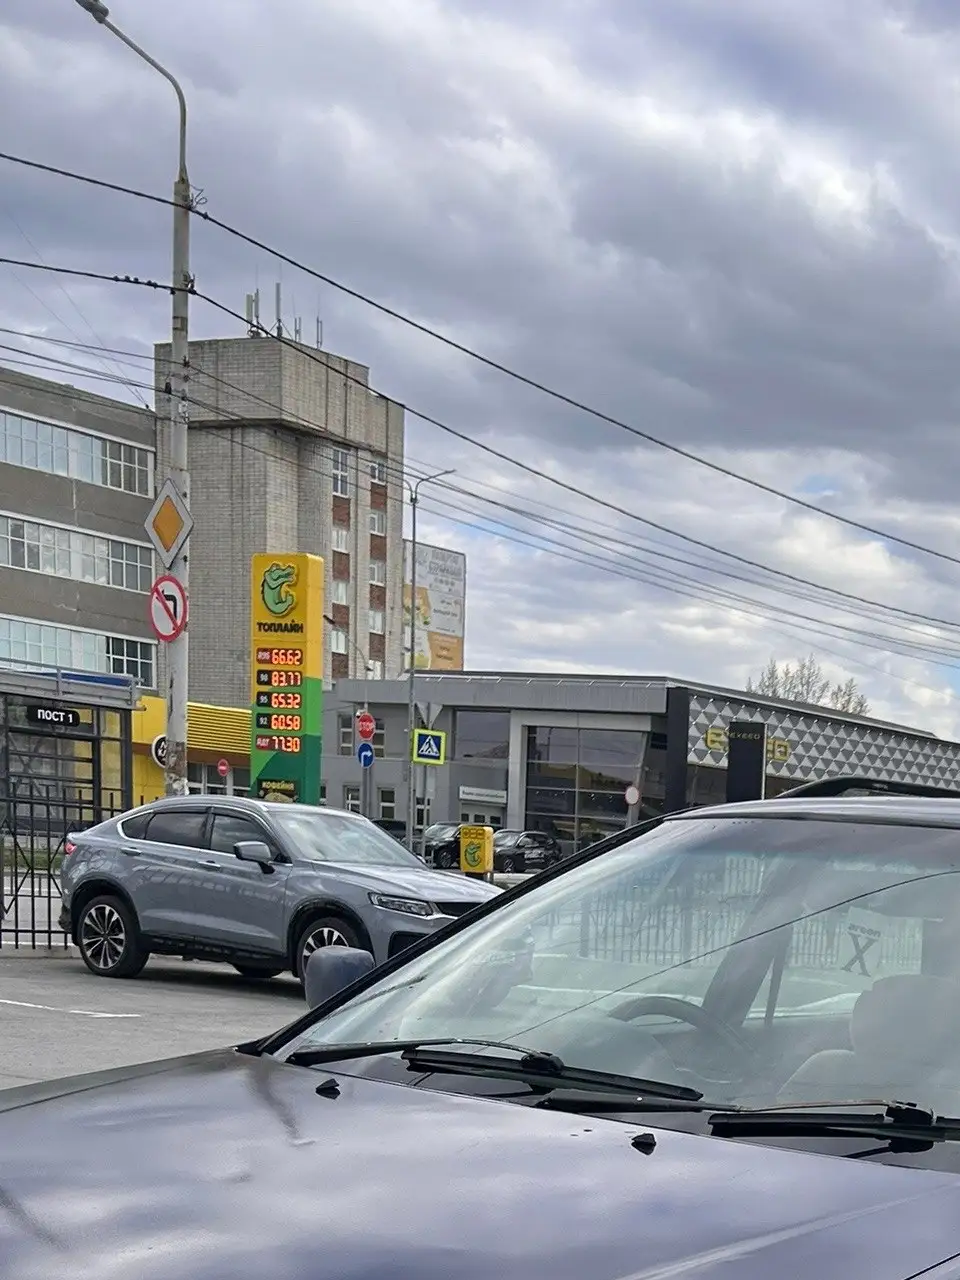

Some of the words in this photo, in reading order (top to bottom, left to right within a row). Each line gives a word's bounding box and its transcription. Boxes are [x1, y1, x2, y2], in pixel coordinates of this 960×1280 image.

[256, 619, 304, 633] ТОПЛАЙН
[272, 671, 301, 686] 83.77
[271, 693, 301, 708] 65.32
[37, 709, 65, 721] ПОСТ
[68, 714, 73, 723] 1
